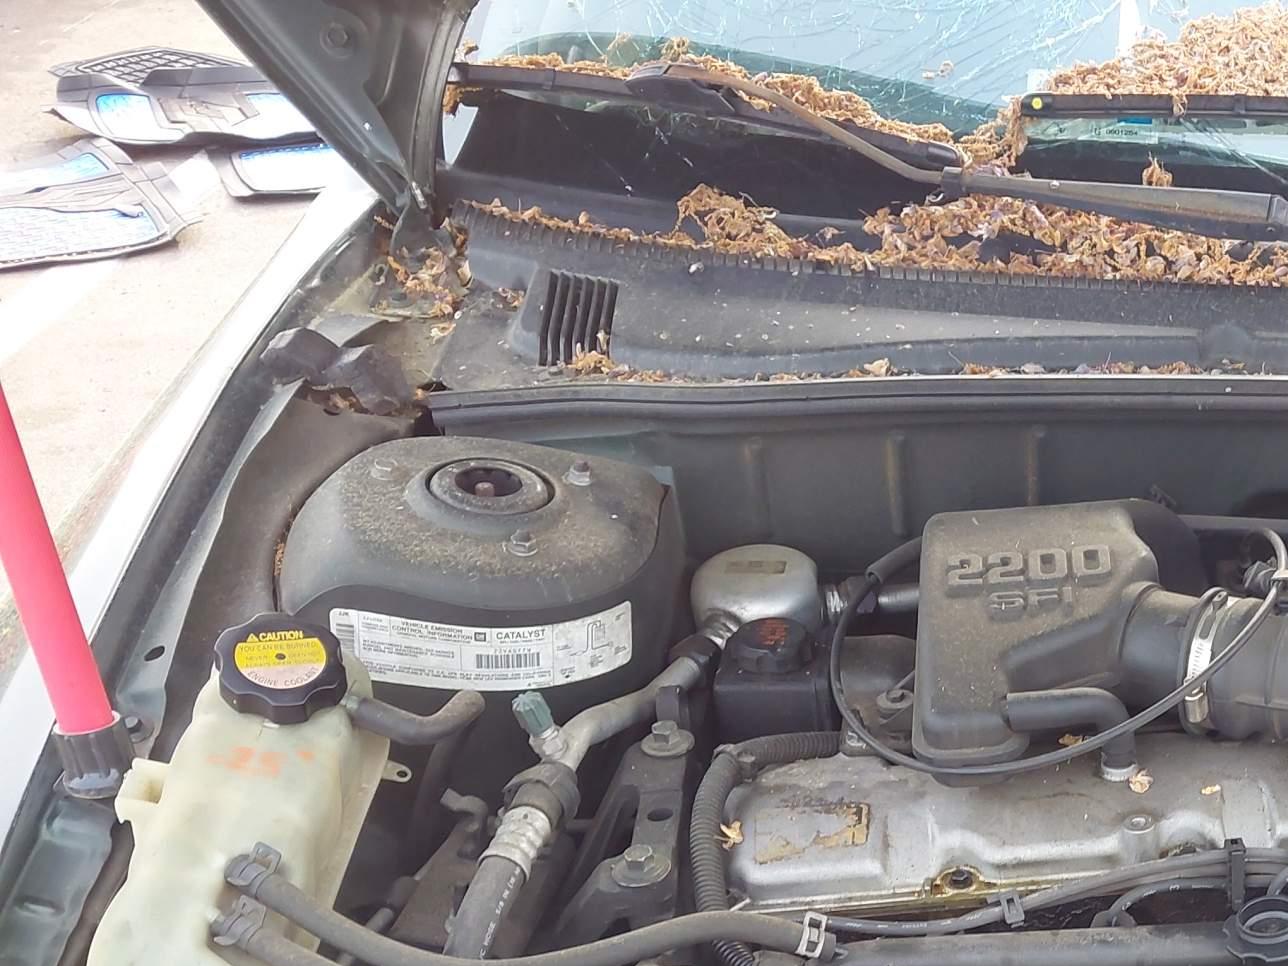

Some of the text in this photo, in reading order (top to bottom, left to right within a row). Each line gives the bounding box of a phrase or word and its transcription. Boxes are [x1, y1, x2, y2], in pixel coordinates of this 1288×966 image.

[947, 544, 1112, 592] 2200
[259, 631, 304, 642] CAUTION
[496, 629, 546, 640] CATALYST
